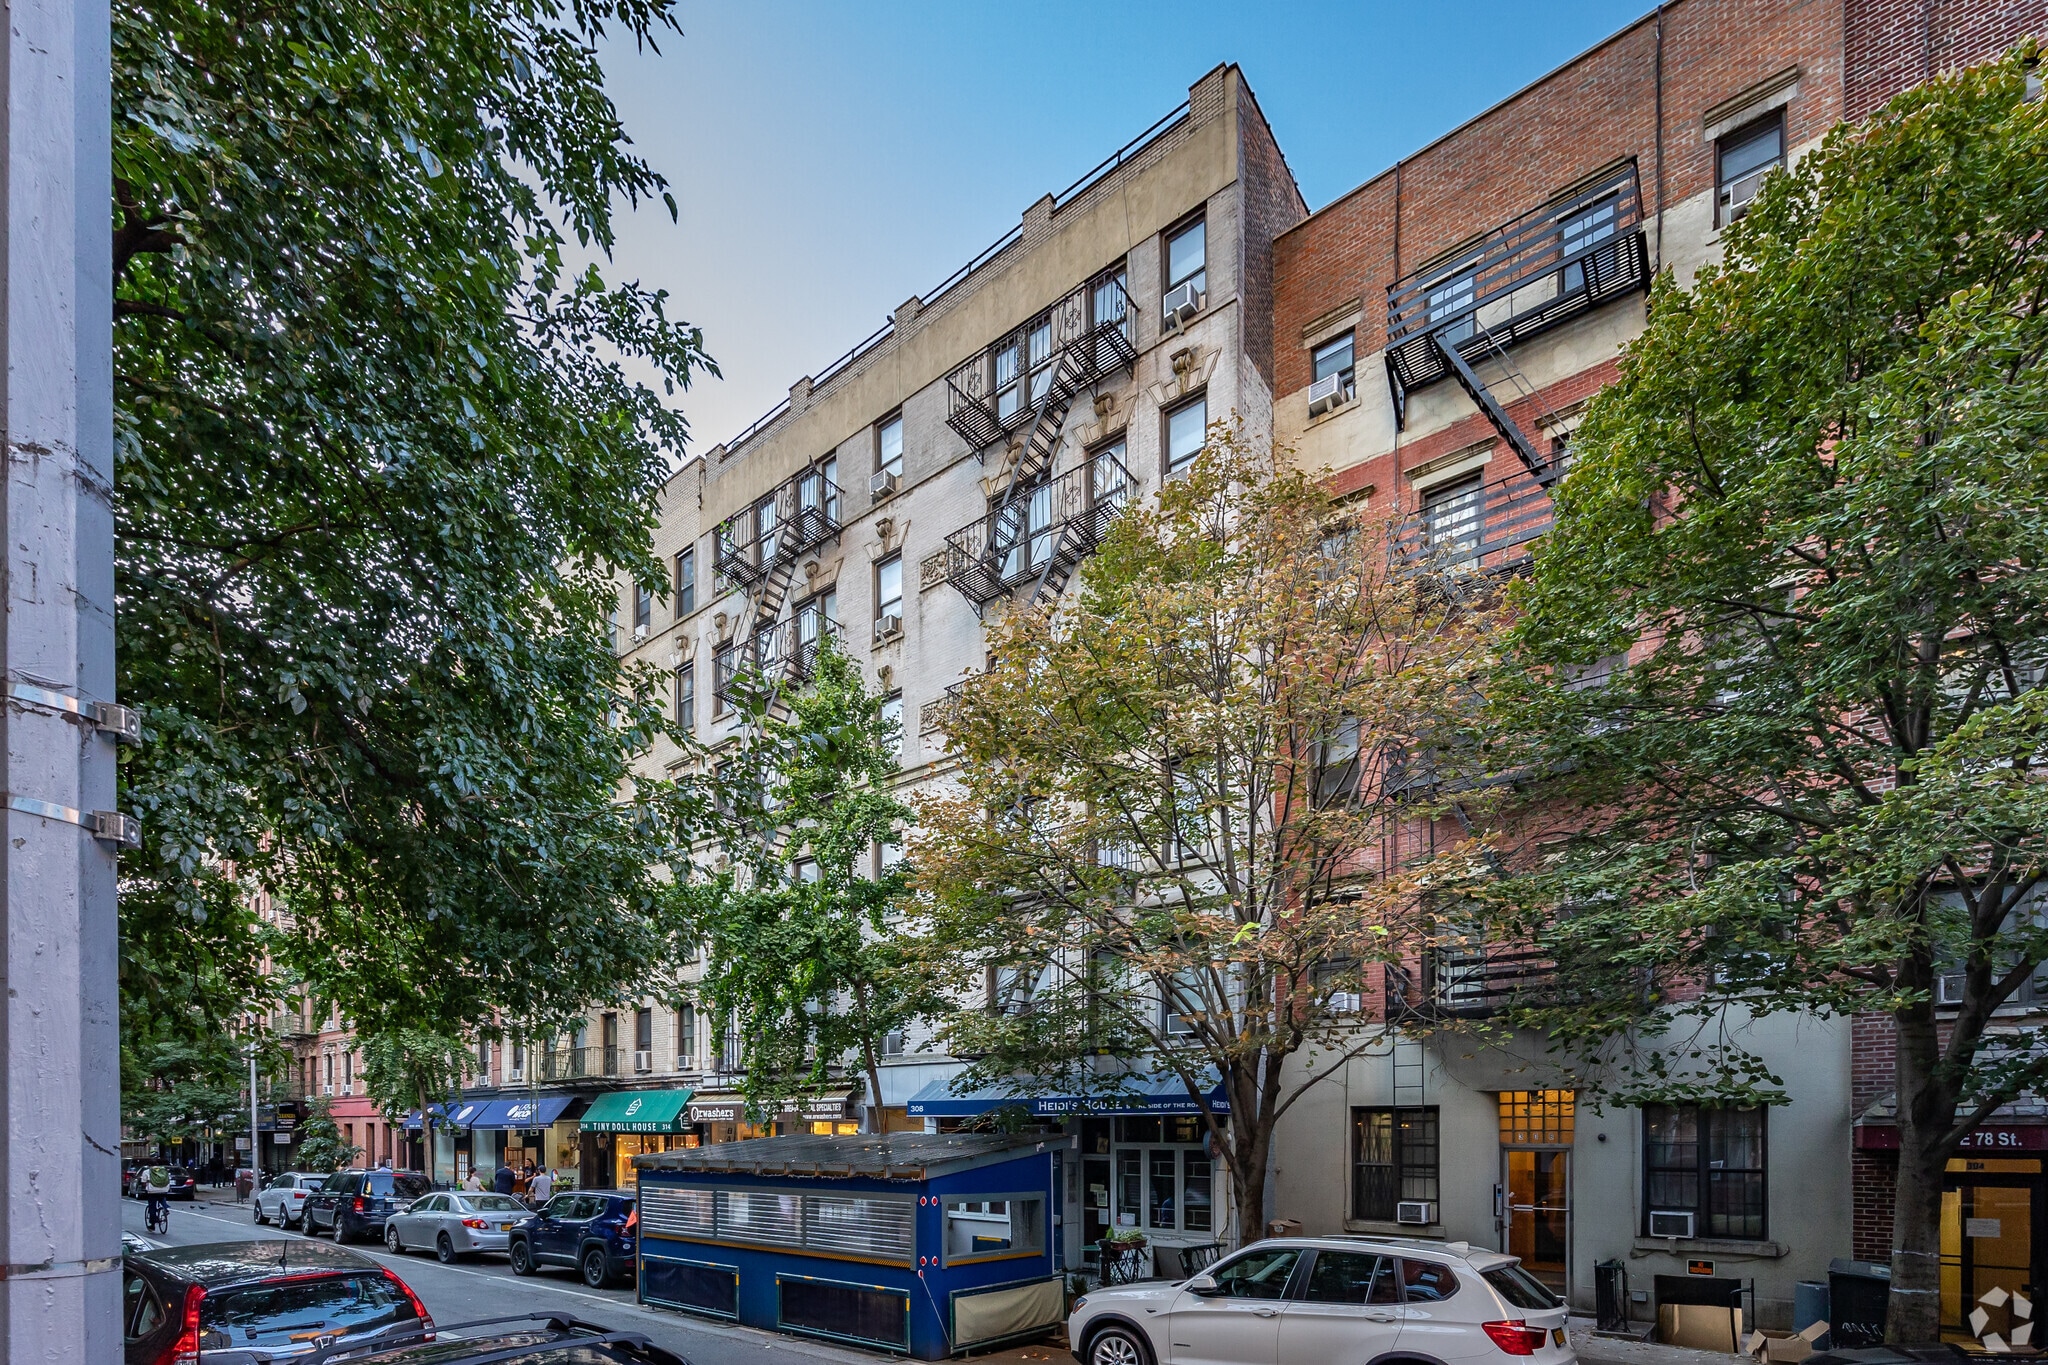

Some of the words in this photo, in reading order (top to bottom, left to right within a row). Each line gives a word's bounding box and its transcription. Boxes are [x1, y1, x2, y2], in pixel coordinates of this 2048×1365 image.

[816, 1102, 842, 1111] SPECIALTIES
[1039, 1101, 1078, 1111] HEIDI'S
[691, 1106, 734, 1121] Orwashers
[593, 1122, 610, 1131] TINY
[612, 1122, 630, 1131] DOLL
[632, 1122, 657, 1131] HOUSE
[1975, 1132, 1994, 1146] 78
[1998, 1132, 2022, 1146] St.
